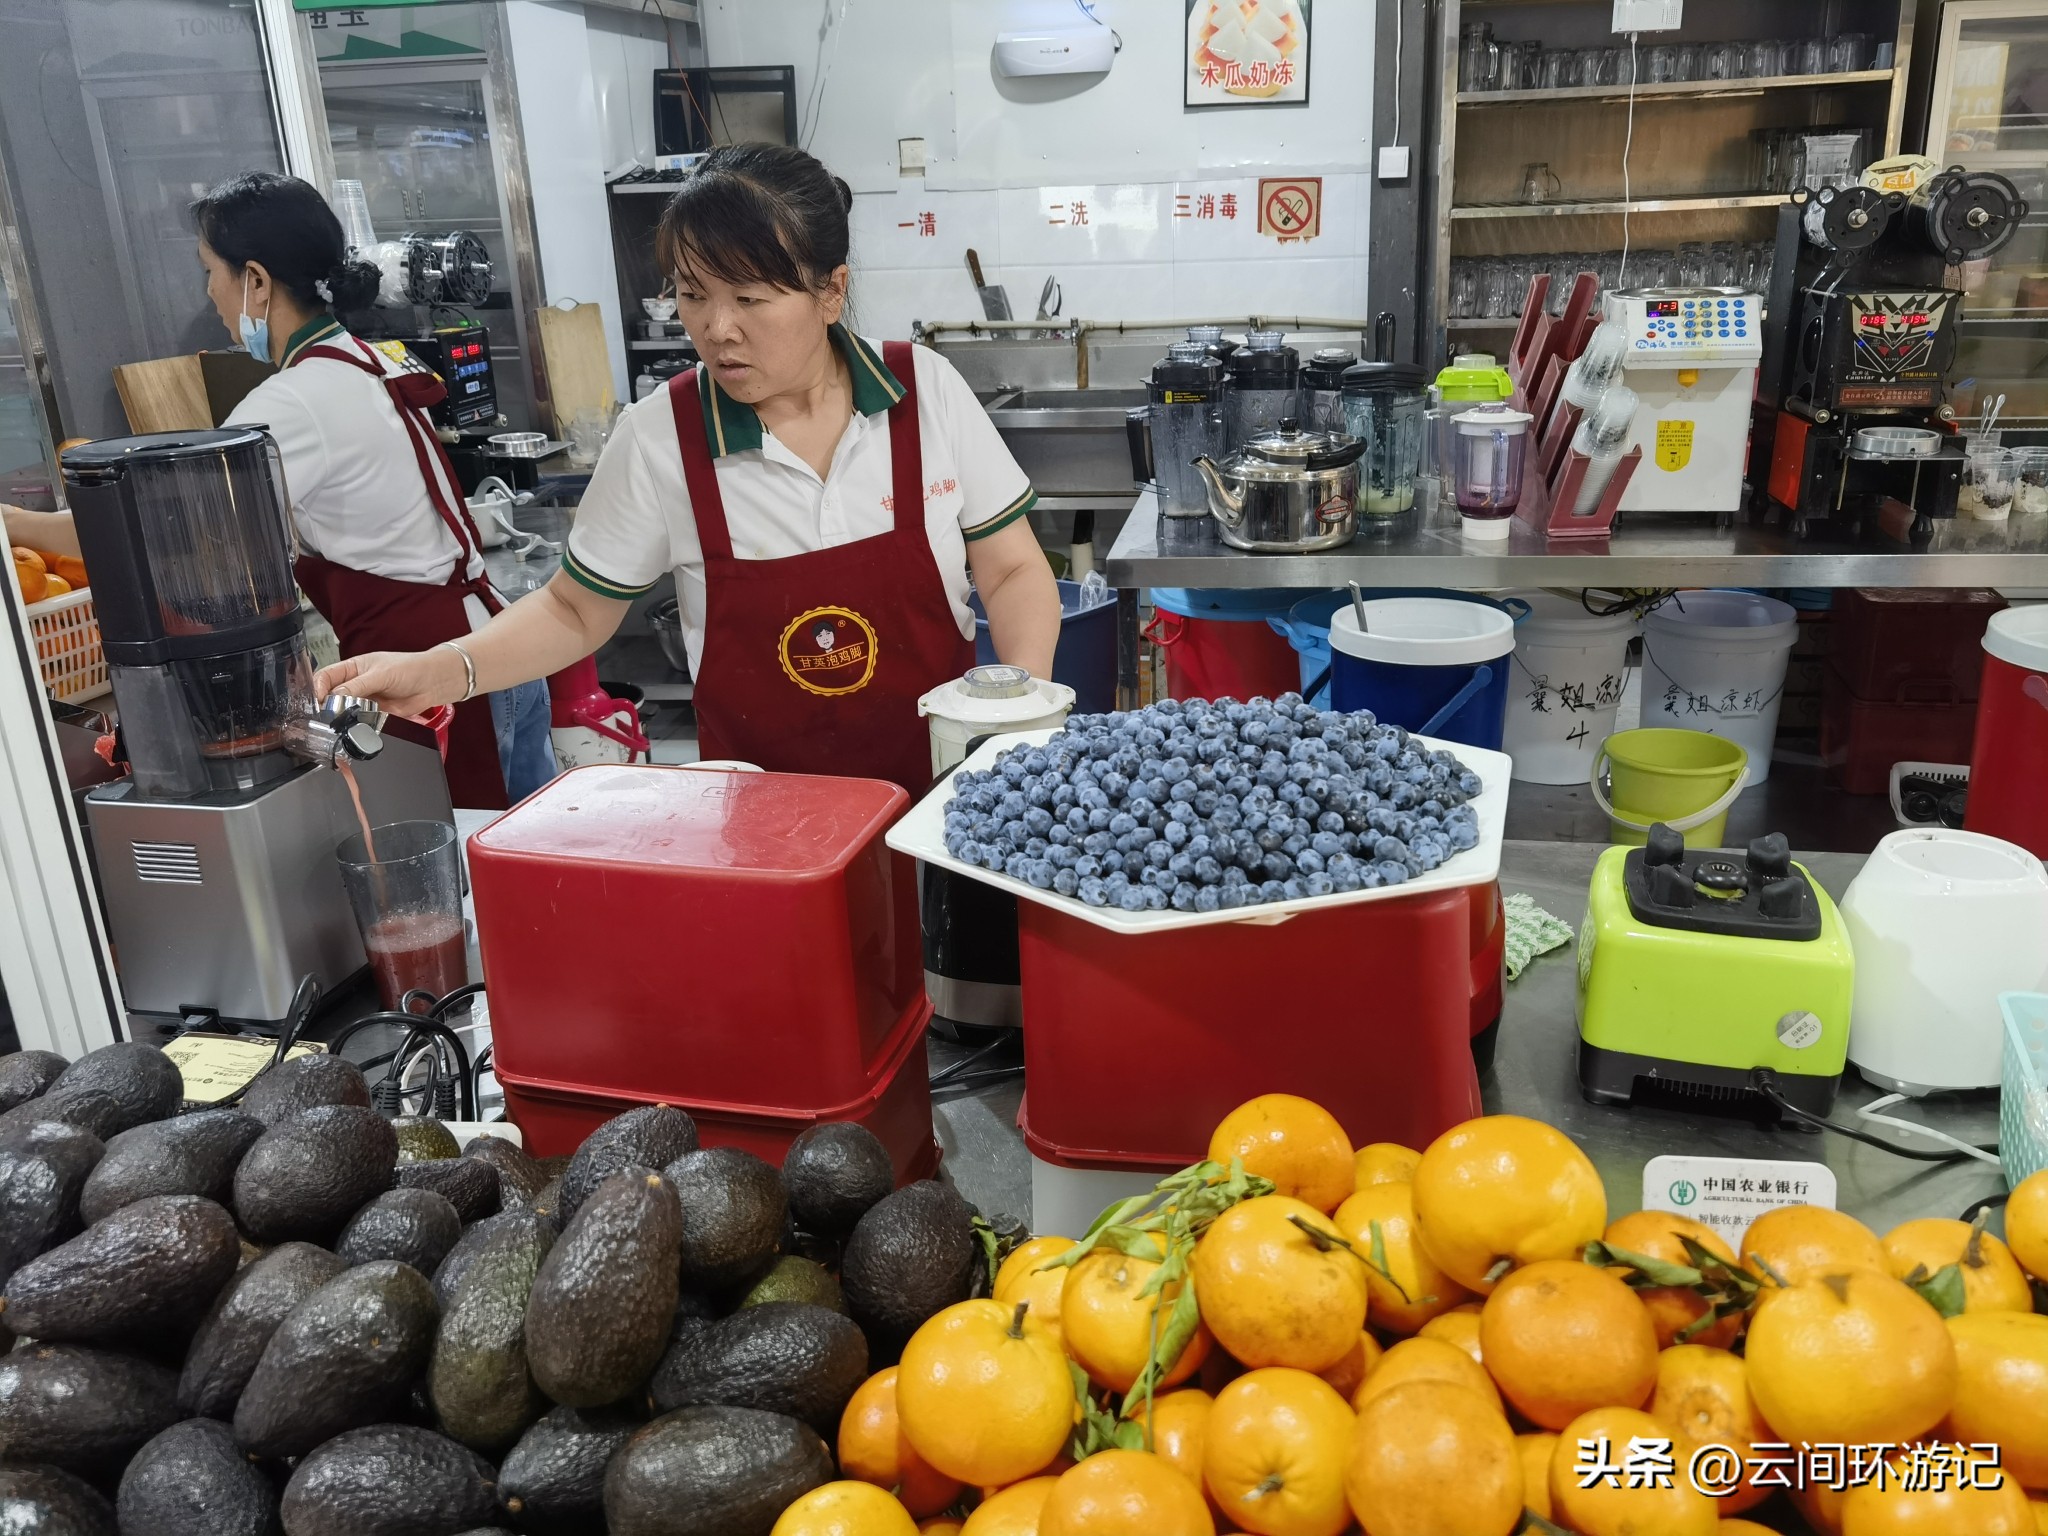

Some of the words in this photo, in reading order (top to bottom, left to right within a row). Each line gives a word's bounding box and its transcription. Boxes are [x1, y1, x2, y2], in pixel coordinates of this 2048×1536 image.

[1200, 59, 1294, 88] 木瓜奶冻
[1049, 200, 1089, 226] 二洗
[1173, 193, 1238, 220] 三消毒
[897, 211, 937, 237] 一清
[880, 478, 956, 512] 甘鸡脚
[800, 645, 862, 669] 甘英泡鸡脚
[1566, 720, 1590, 750] 4
[1703, 1176, 1810, 1195] 中国农业银行
